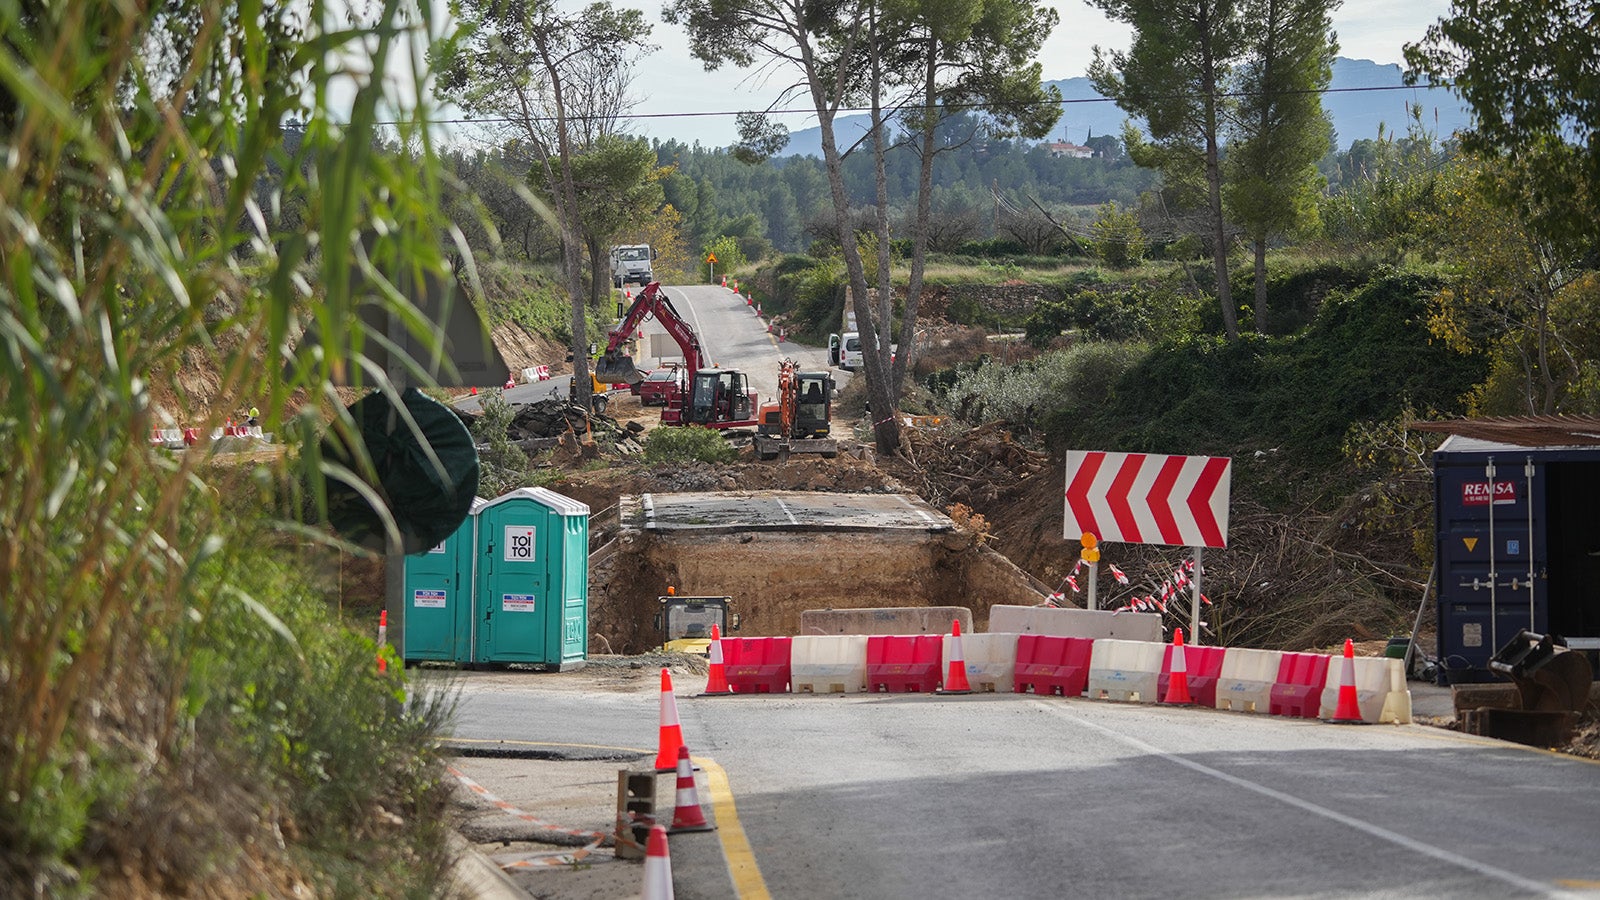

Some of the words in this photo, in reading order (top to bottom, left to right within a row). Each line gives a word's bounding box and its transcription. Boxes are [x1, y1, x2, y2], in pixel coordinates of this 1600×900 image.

[1464, 482, 1514, 495] REMSA
[512, 535, 531, 546] TOI
[512, 546, 531, 557] TOI
